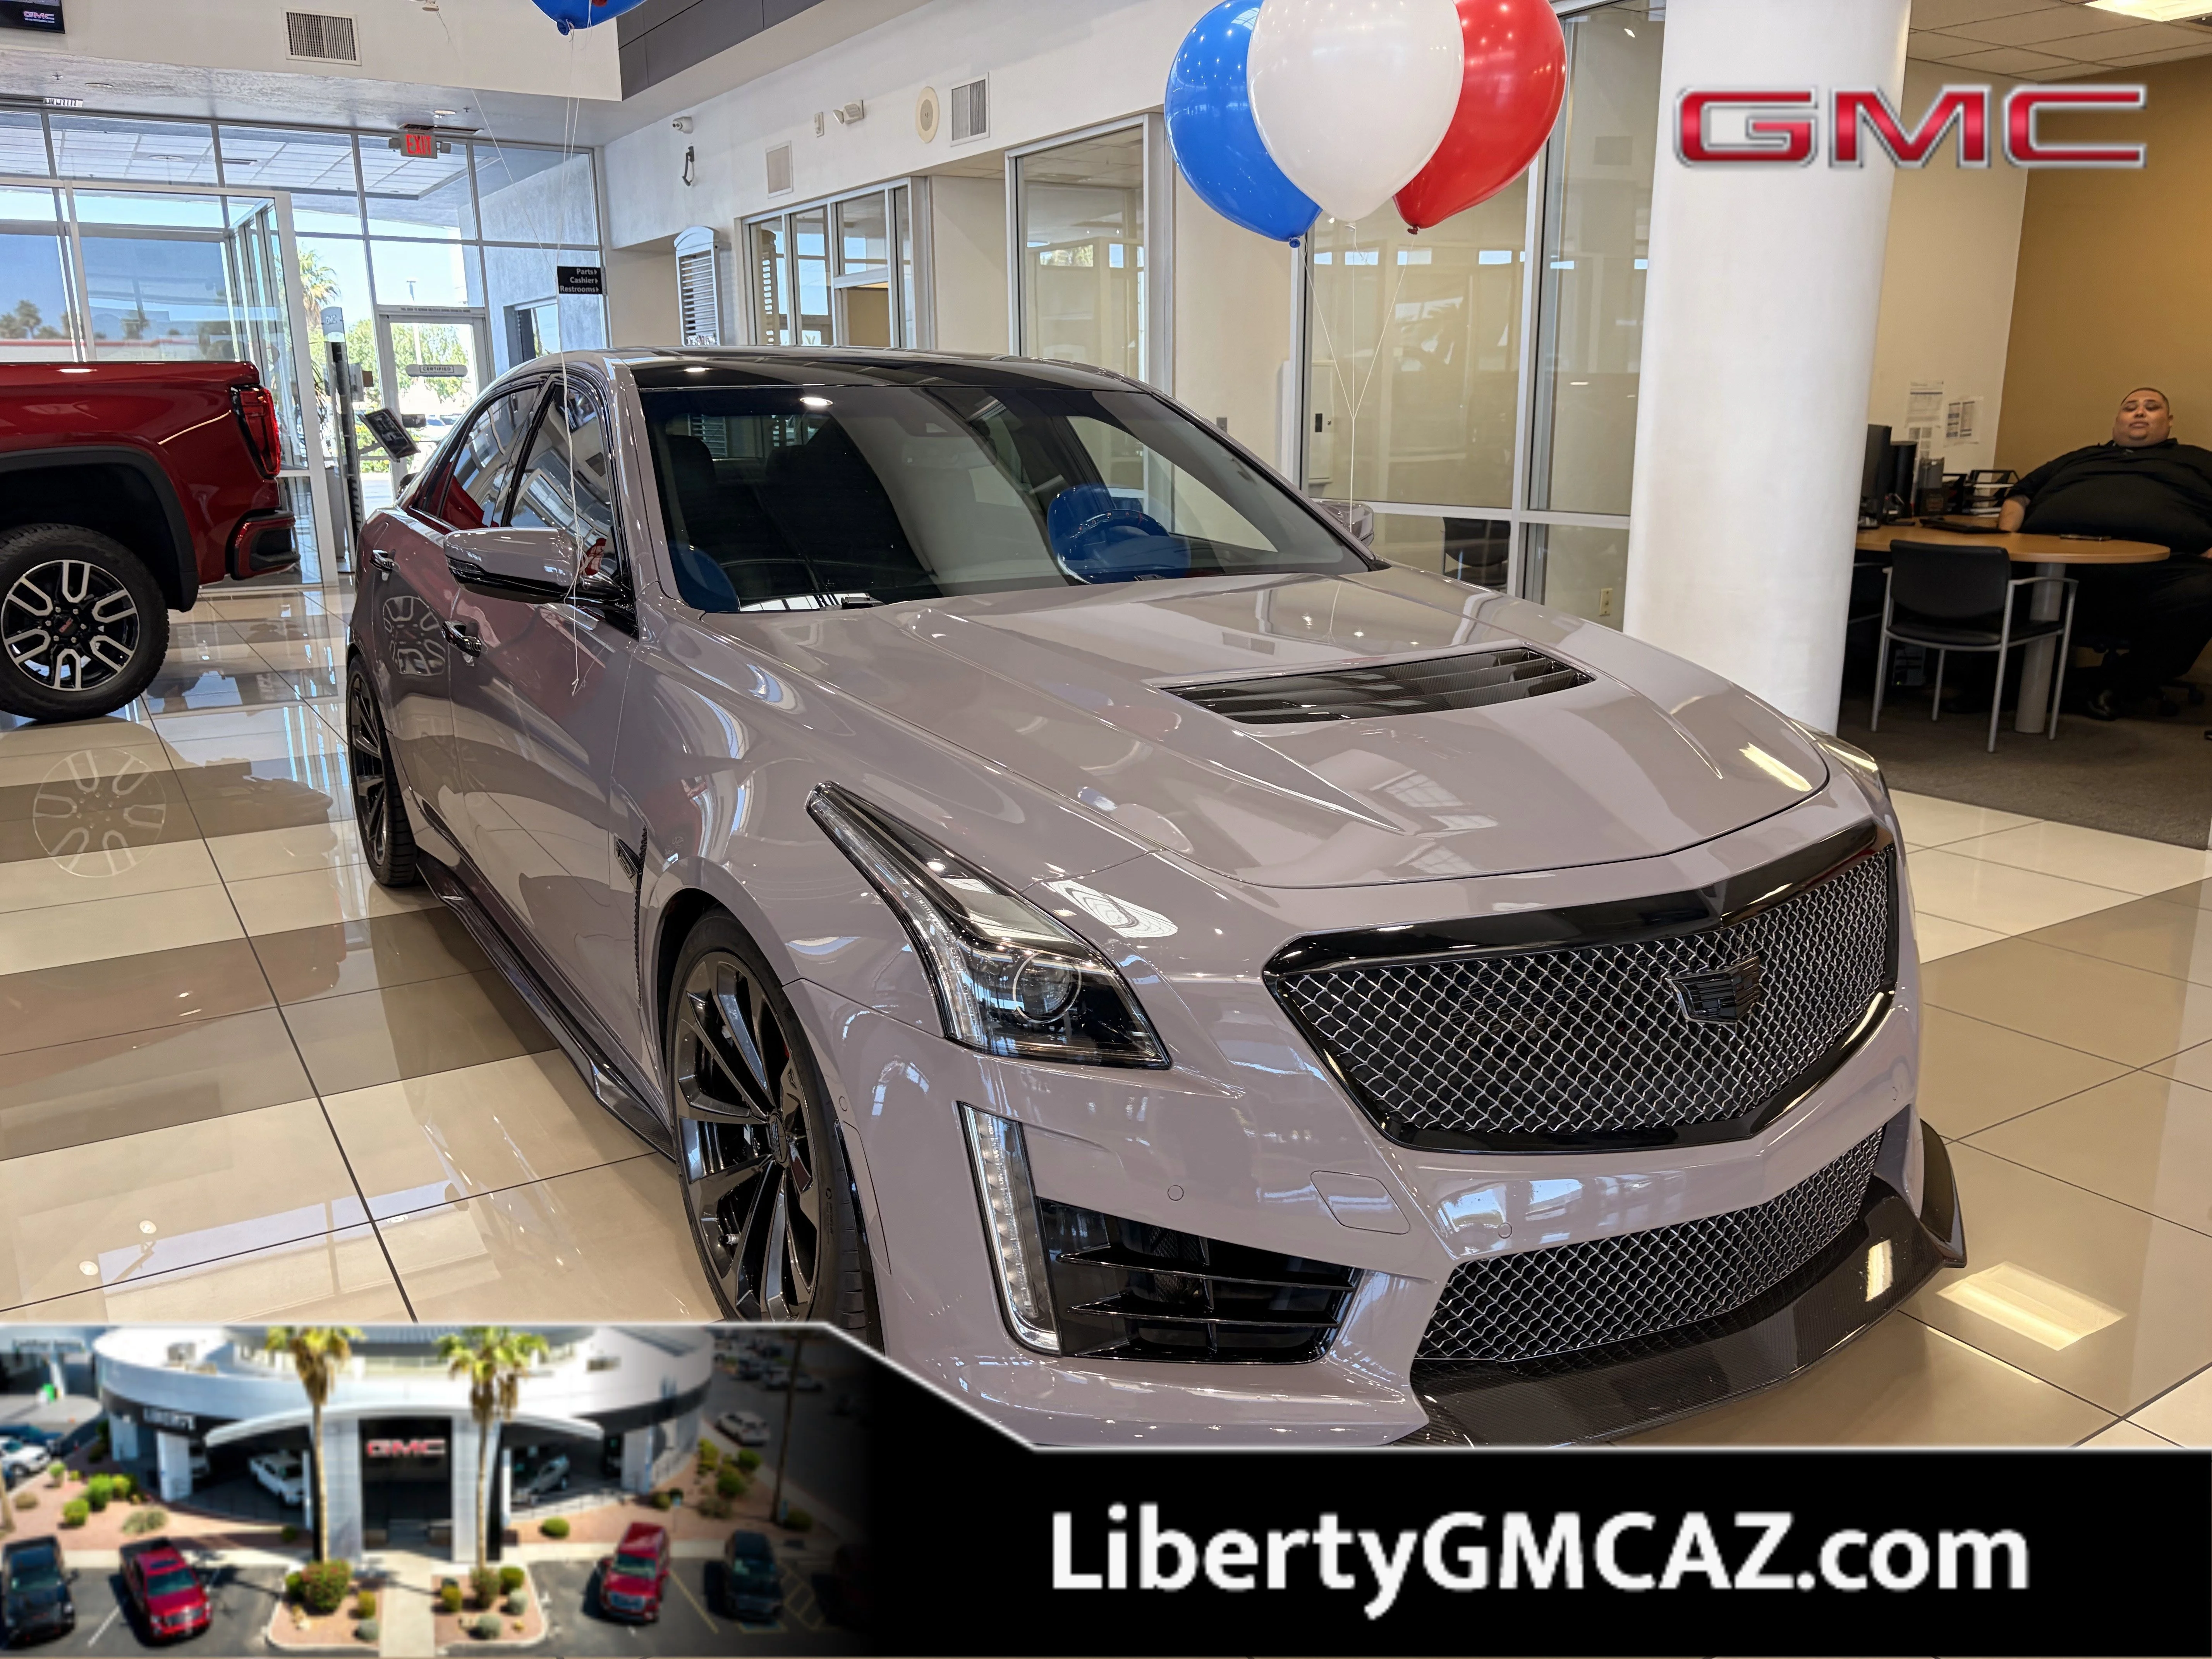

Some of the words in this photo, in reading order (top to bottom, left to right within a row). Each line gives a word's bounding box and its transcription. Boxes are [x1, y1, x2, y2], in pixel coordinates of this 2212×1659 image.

[24, 11, 55, 20] GMC
[406, 134, 431, 156] EXIT
[59, 617, 74, 633] GMC
